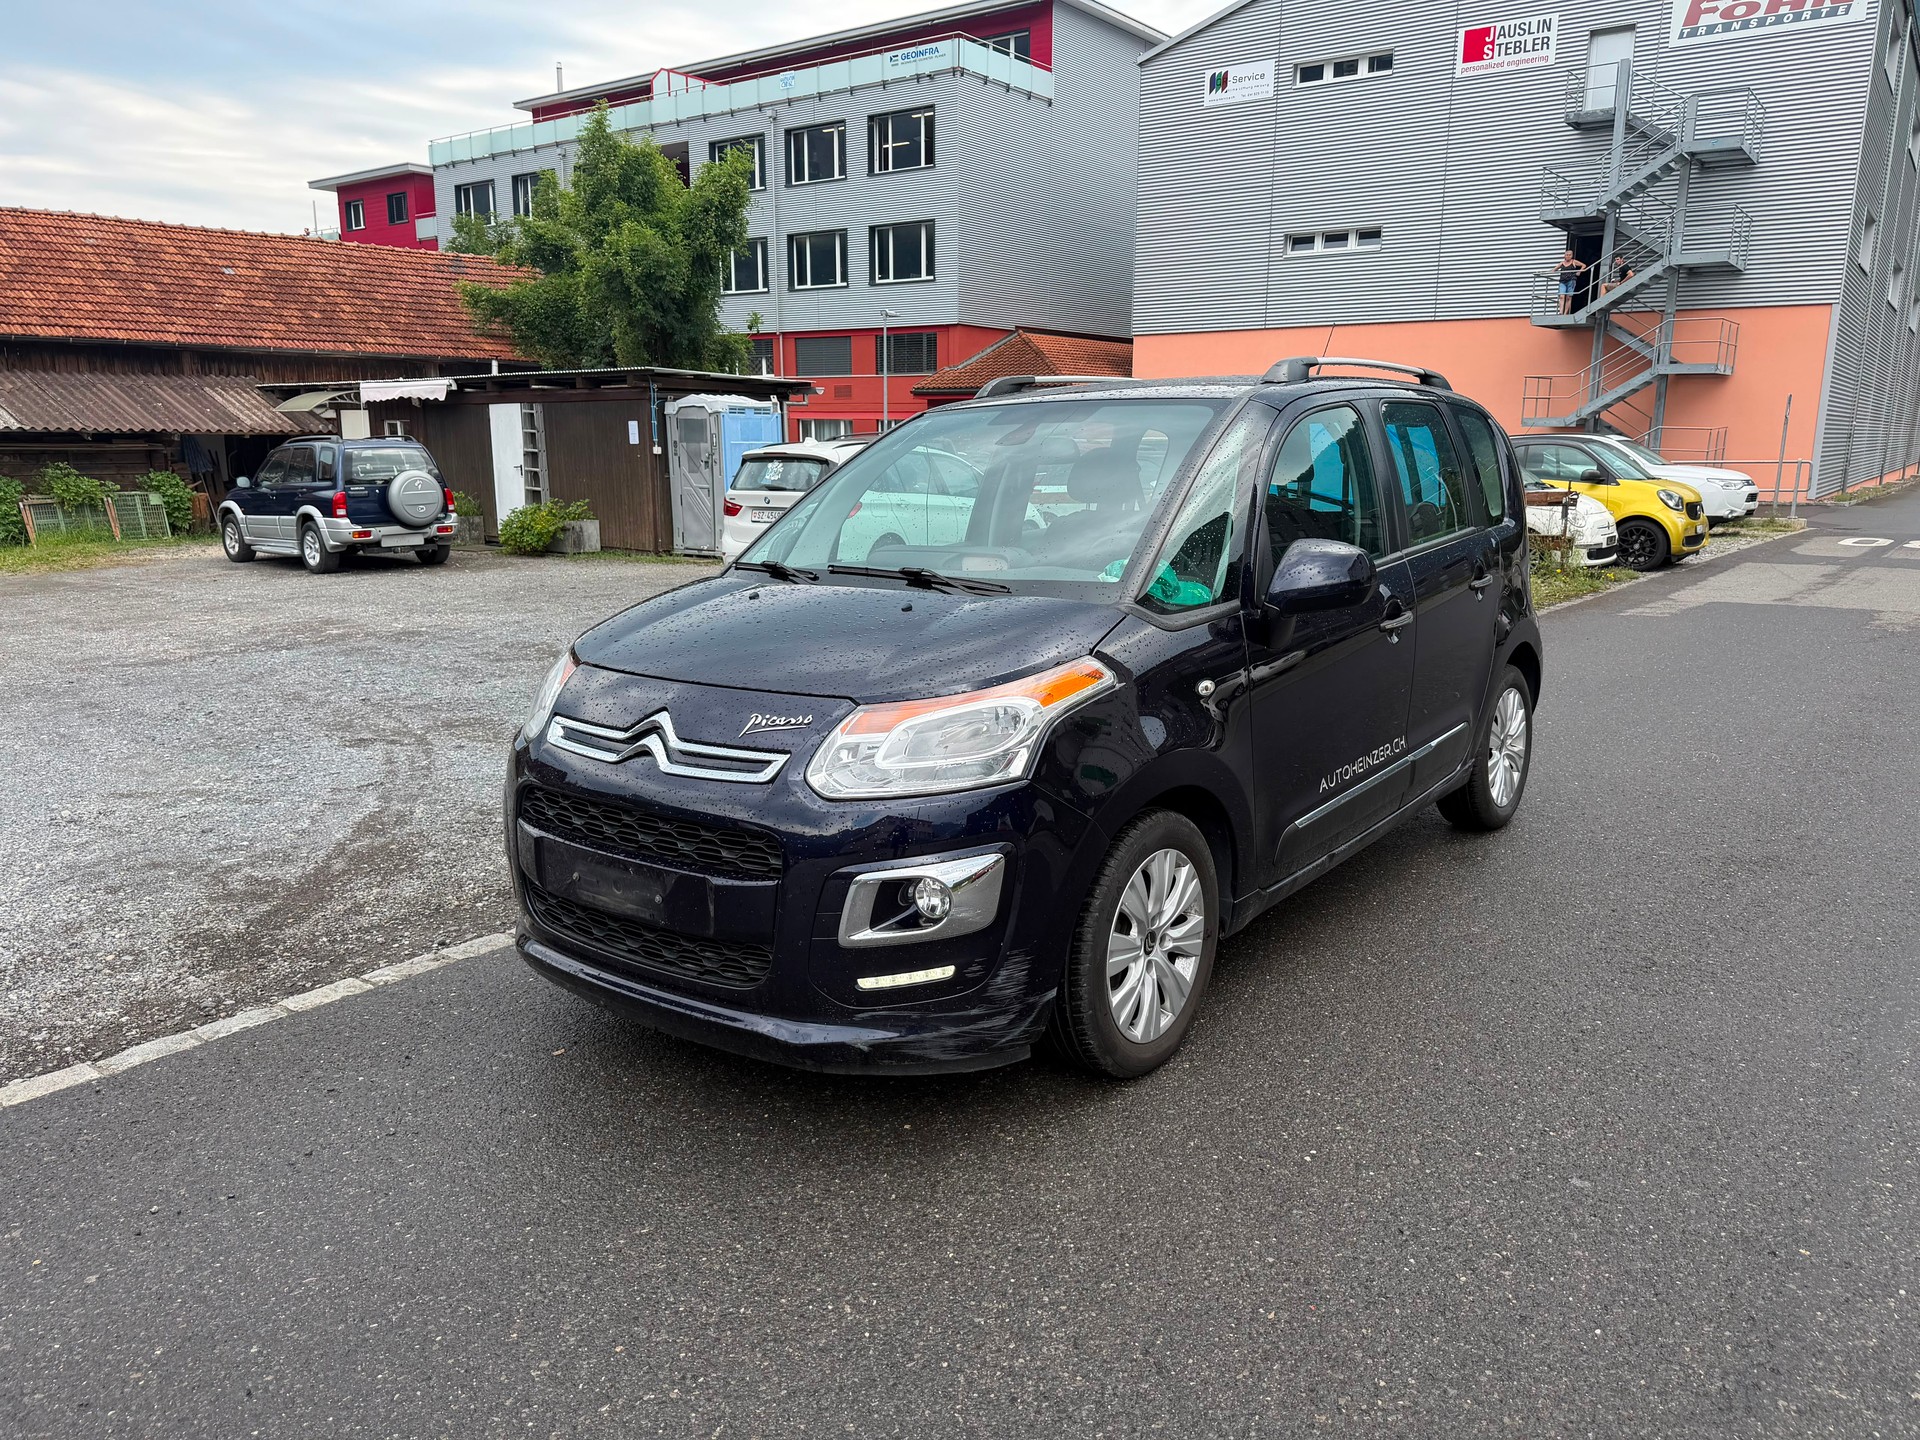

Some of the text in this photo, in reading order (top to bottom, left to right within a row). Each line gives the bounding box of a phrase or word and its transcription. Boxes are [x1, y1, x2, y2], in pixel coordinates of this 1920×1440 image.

[1485, 18, 1552, 42] JAUSLIN
[1682, 5, 1848, 38] TRANSPORTE
[900, 46, 940, 61] GEOINFRA
[1483, 36, 1551, 60] STEBLER
[1460, 54, 1549, 75] personalized engineering
[738, 713, 813, 739] Picasso
[1319, 735, 1406, 793] AUTOHEINZER.CH
